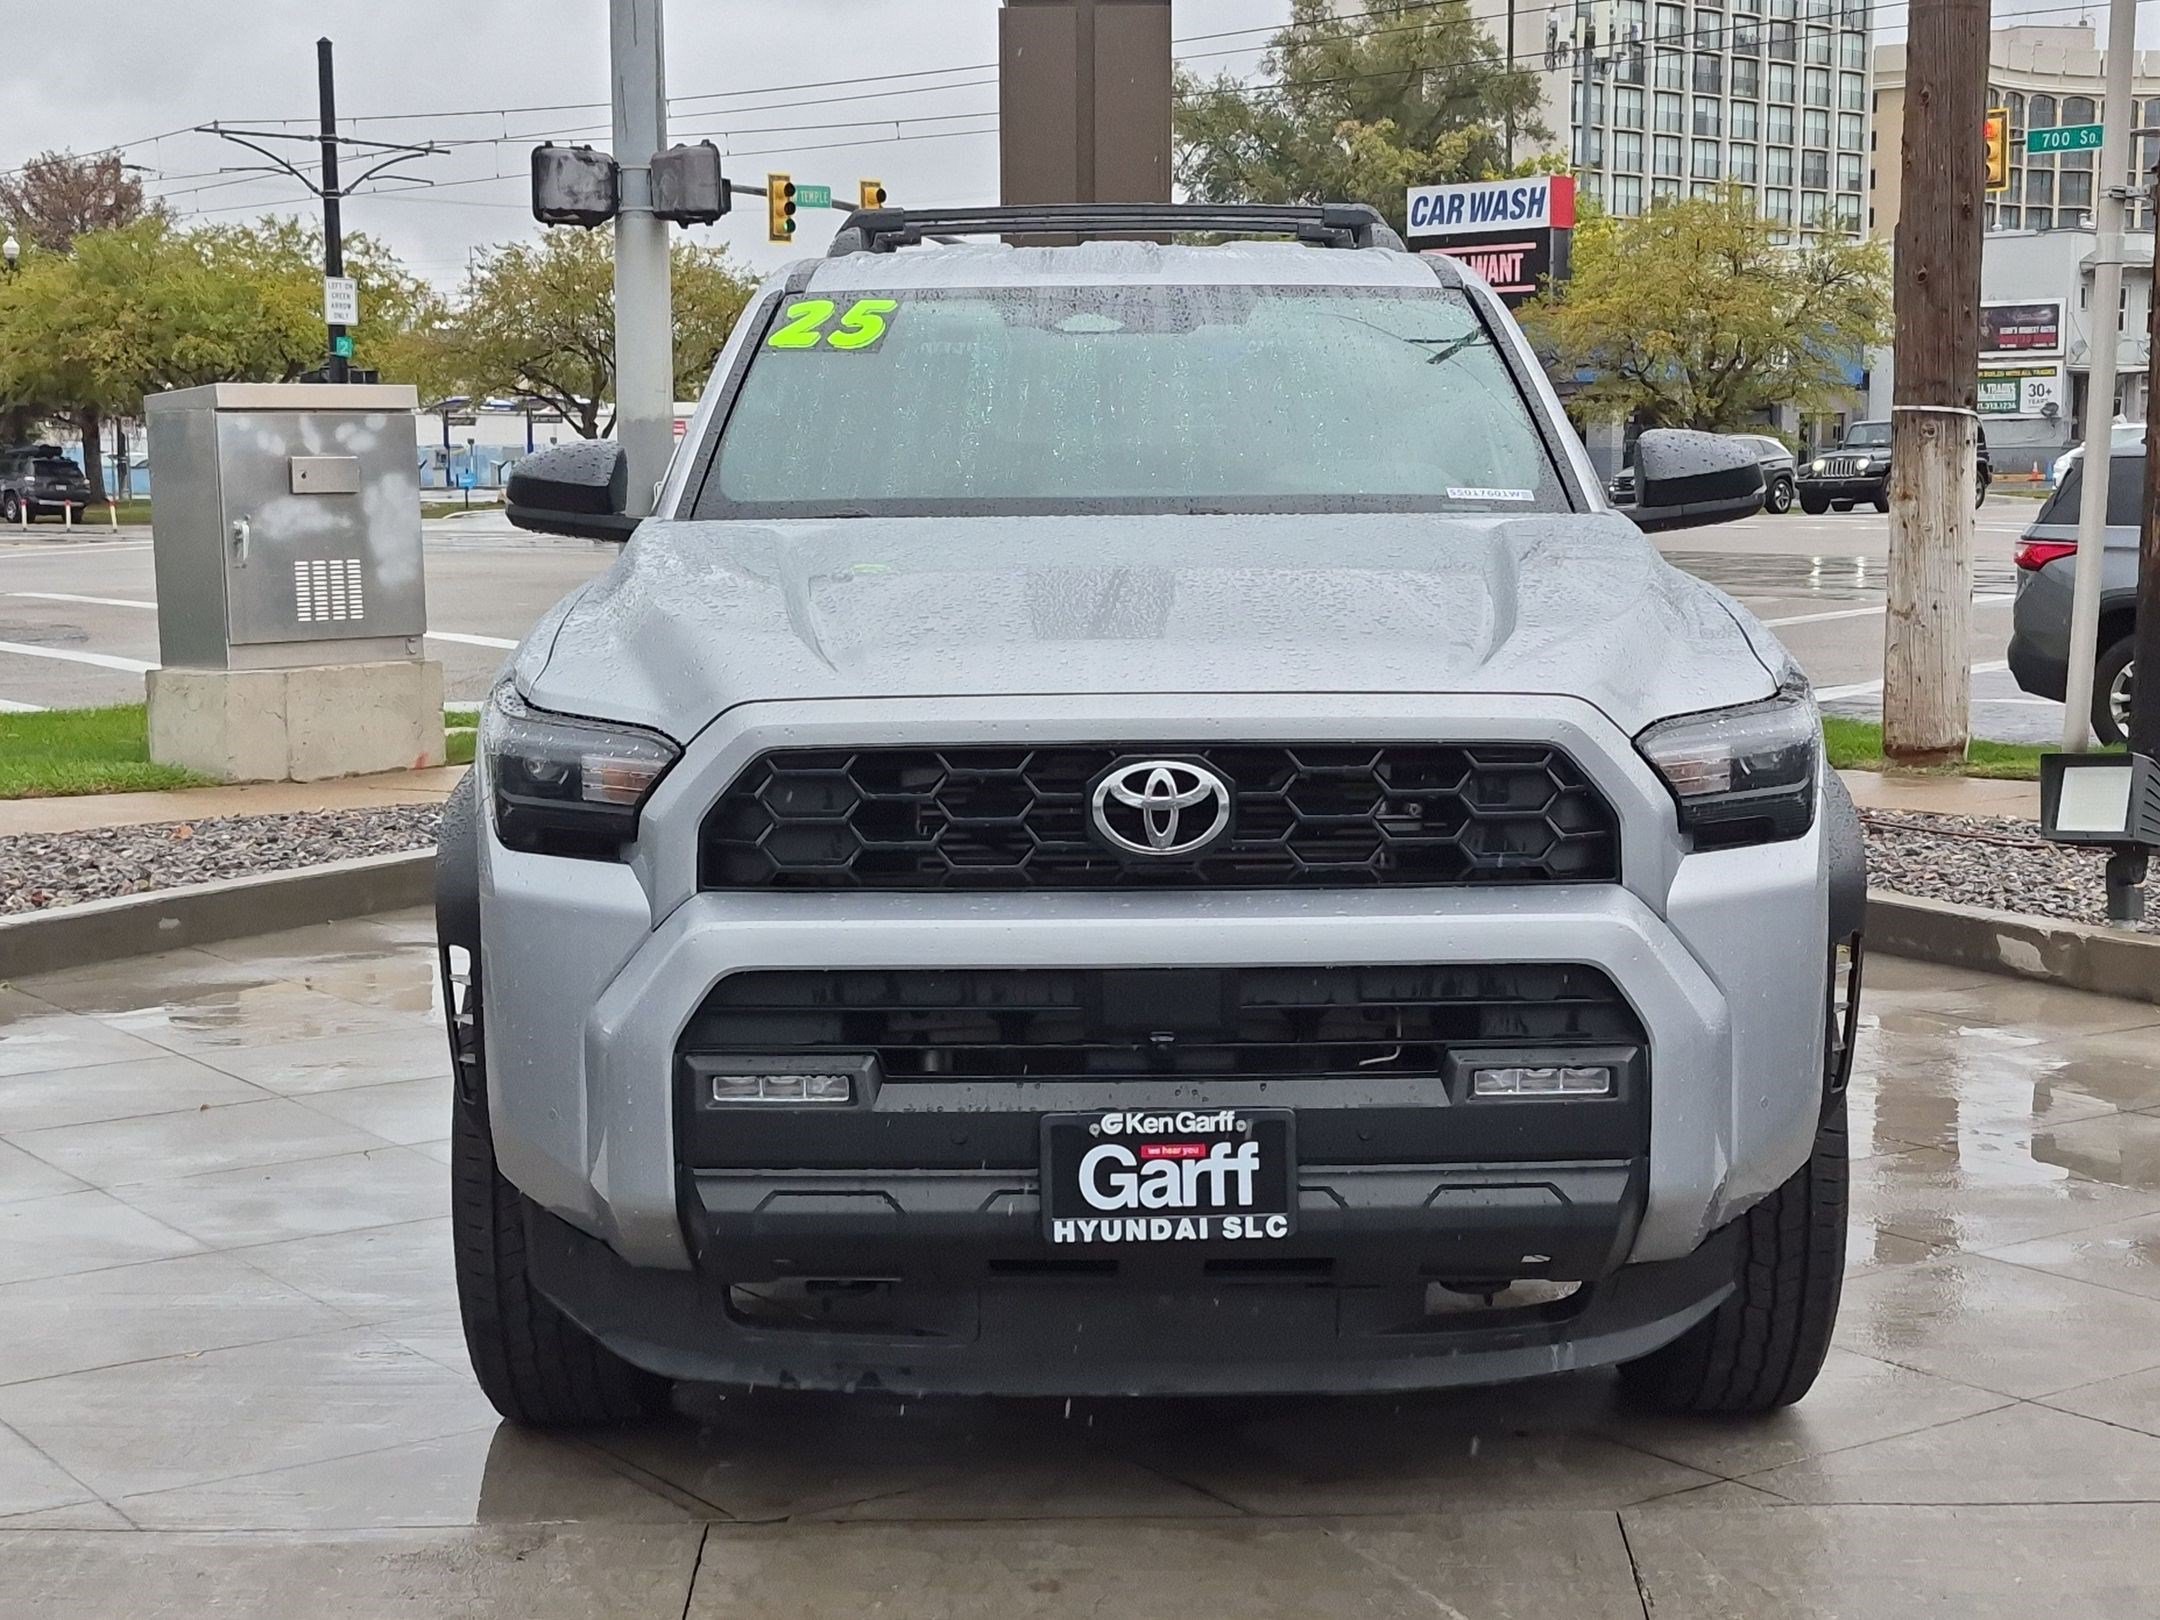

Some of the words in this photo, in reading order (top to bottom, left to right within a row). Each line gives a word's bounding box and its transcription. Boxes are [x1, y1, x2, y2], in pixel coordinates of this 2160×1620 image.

[2042, 132, 2070, 148] 700
[799, 190, 829, 204] TEMPLE
[1410, 192, 1465, 227] CAR
[1469, 186, 1547, 223] WASH
[1470, 252, 1524, 283] WANT
[331, 292, 351, 300] GREEN
[331, 302, 351, 310] ARROW
[768, 299, 898, 350] 25
[2028, 383, 2052, 398] 30+
[1125, 1112, 1175, 1134] Ken
[1175, 1111, 1235, 1133] Garff
[1161, 1146, 1182, 1155] hear
[1182, 1146, 1200, 1156] you
[1078, 1142, 1260, 1211] Garff
[1053, 1217, 1208, 1243] HYUNDAI
[1222, 1214, 1288, 1239] SLC
